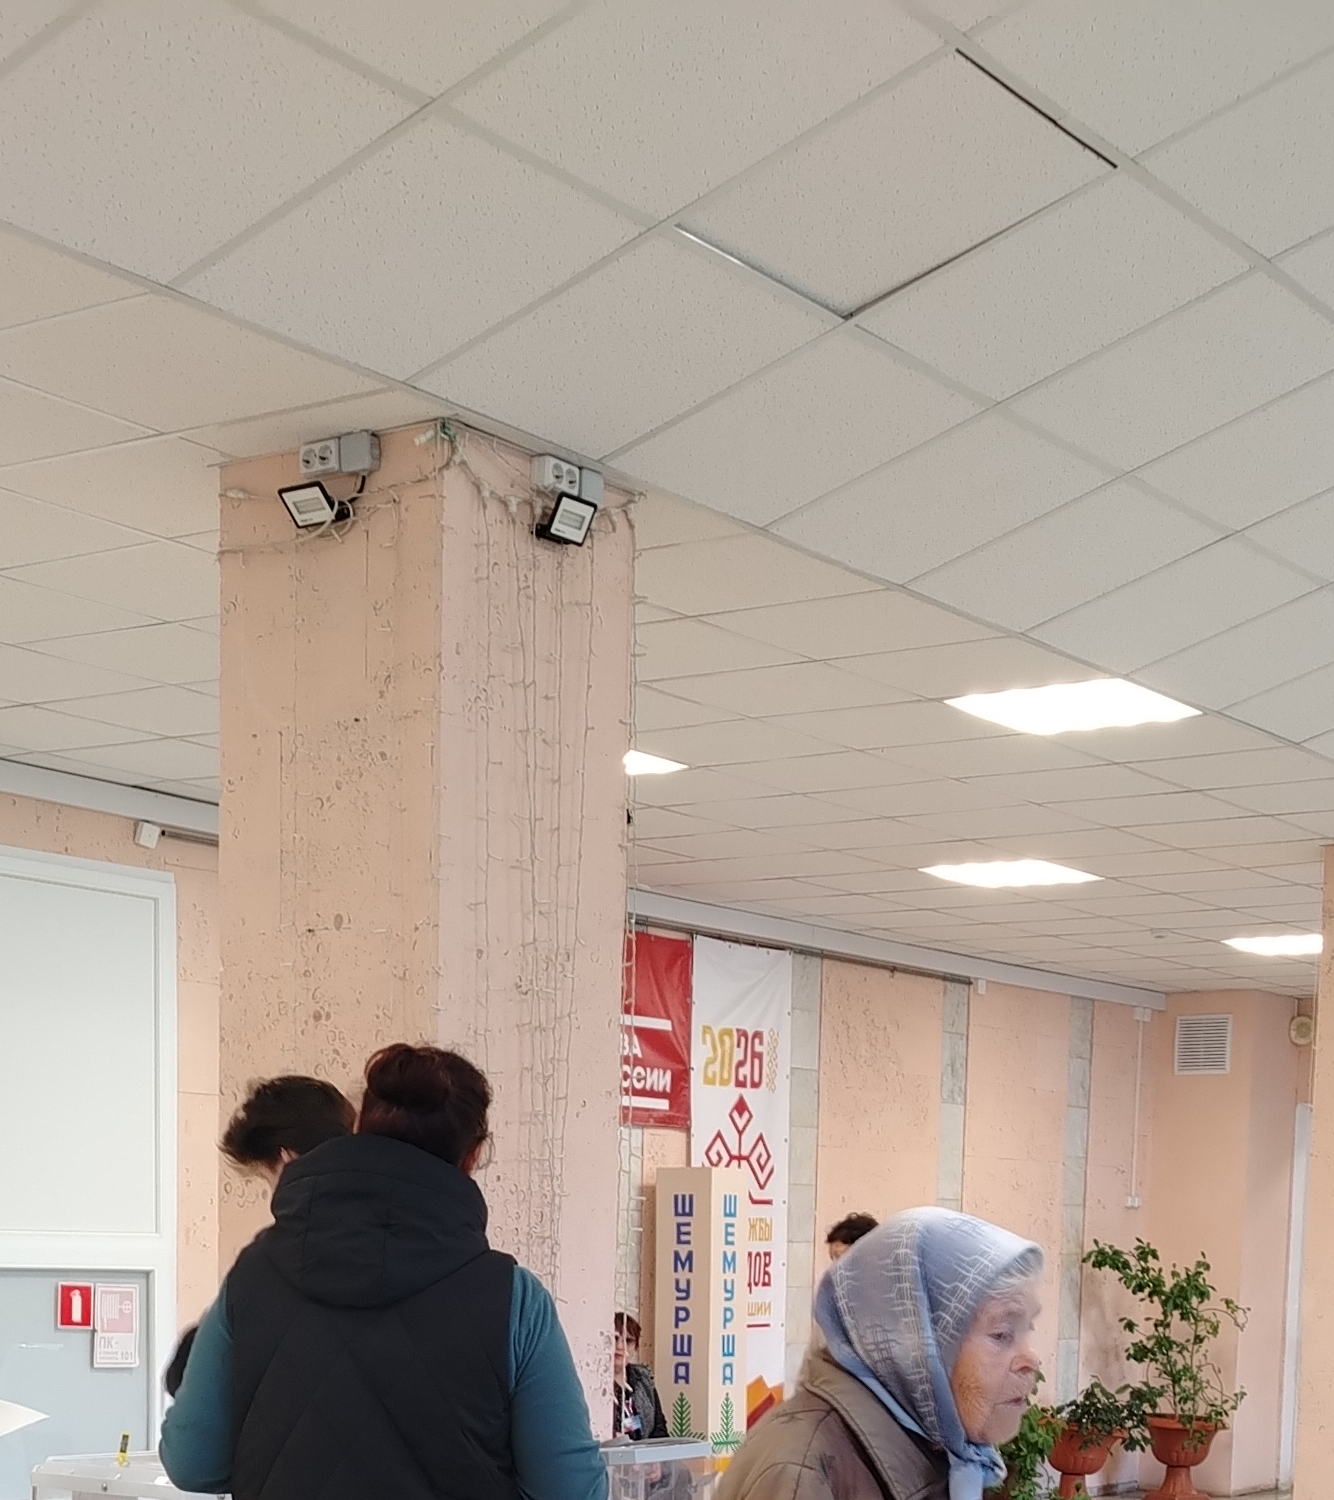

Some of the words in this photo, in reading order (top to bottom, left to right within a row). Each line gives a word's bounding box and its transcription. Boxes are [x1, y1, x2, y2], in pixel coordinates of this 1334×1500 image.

[701, 1024, 764, 1089] 2026
[672, 1193, 694, 1385] ШЕМУРША
[721, 1194, 737, 1385] ШЕМУРША
